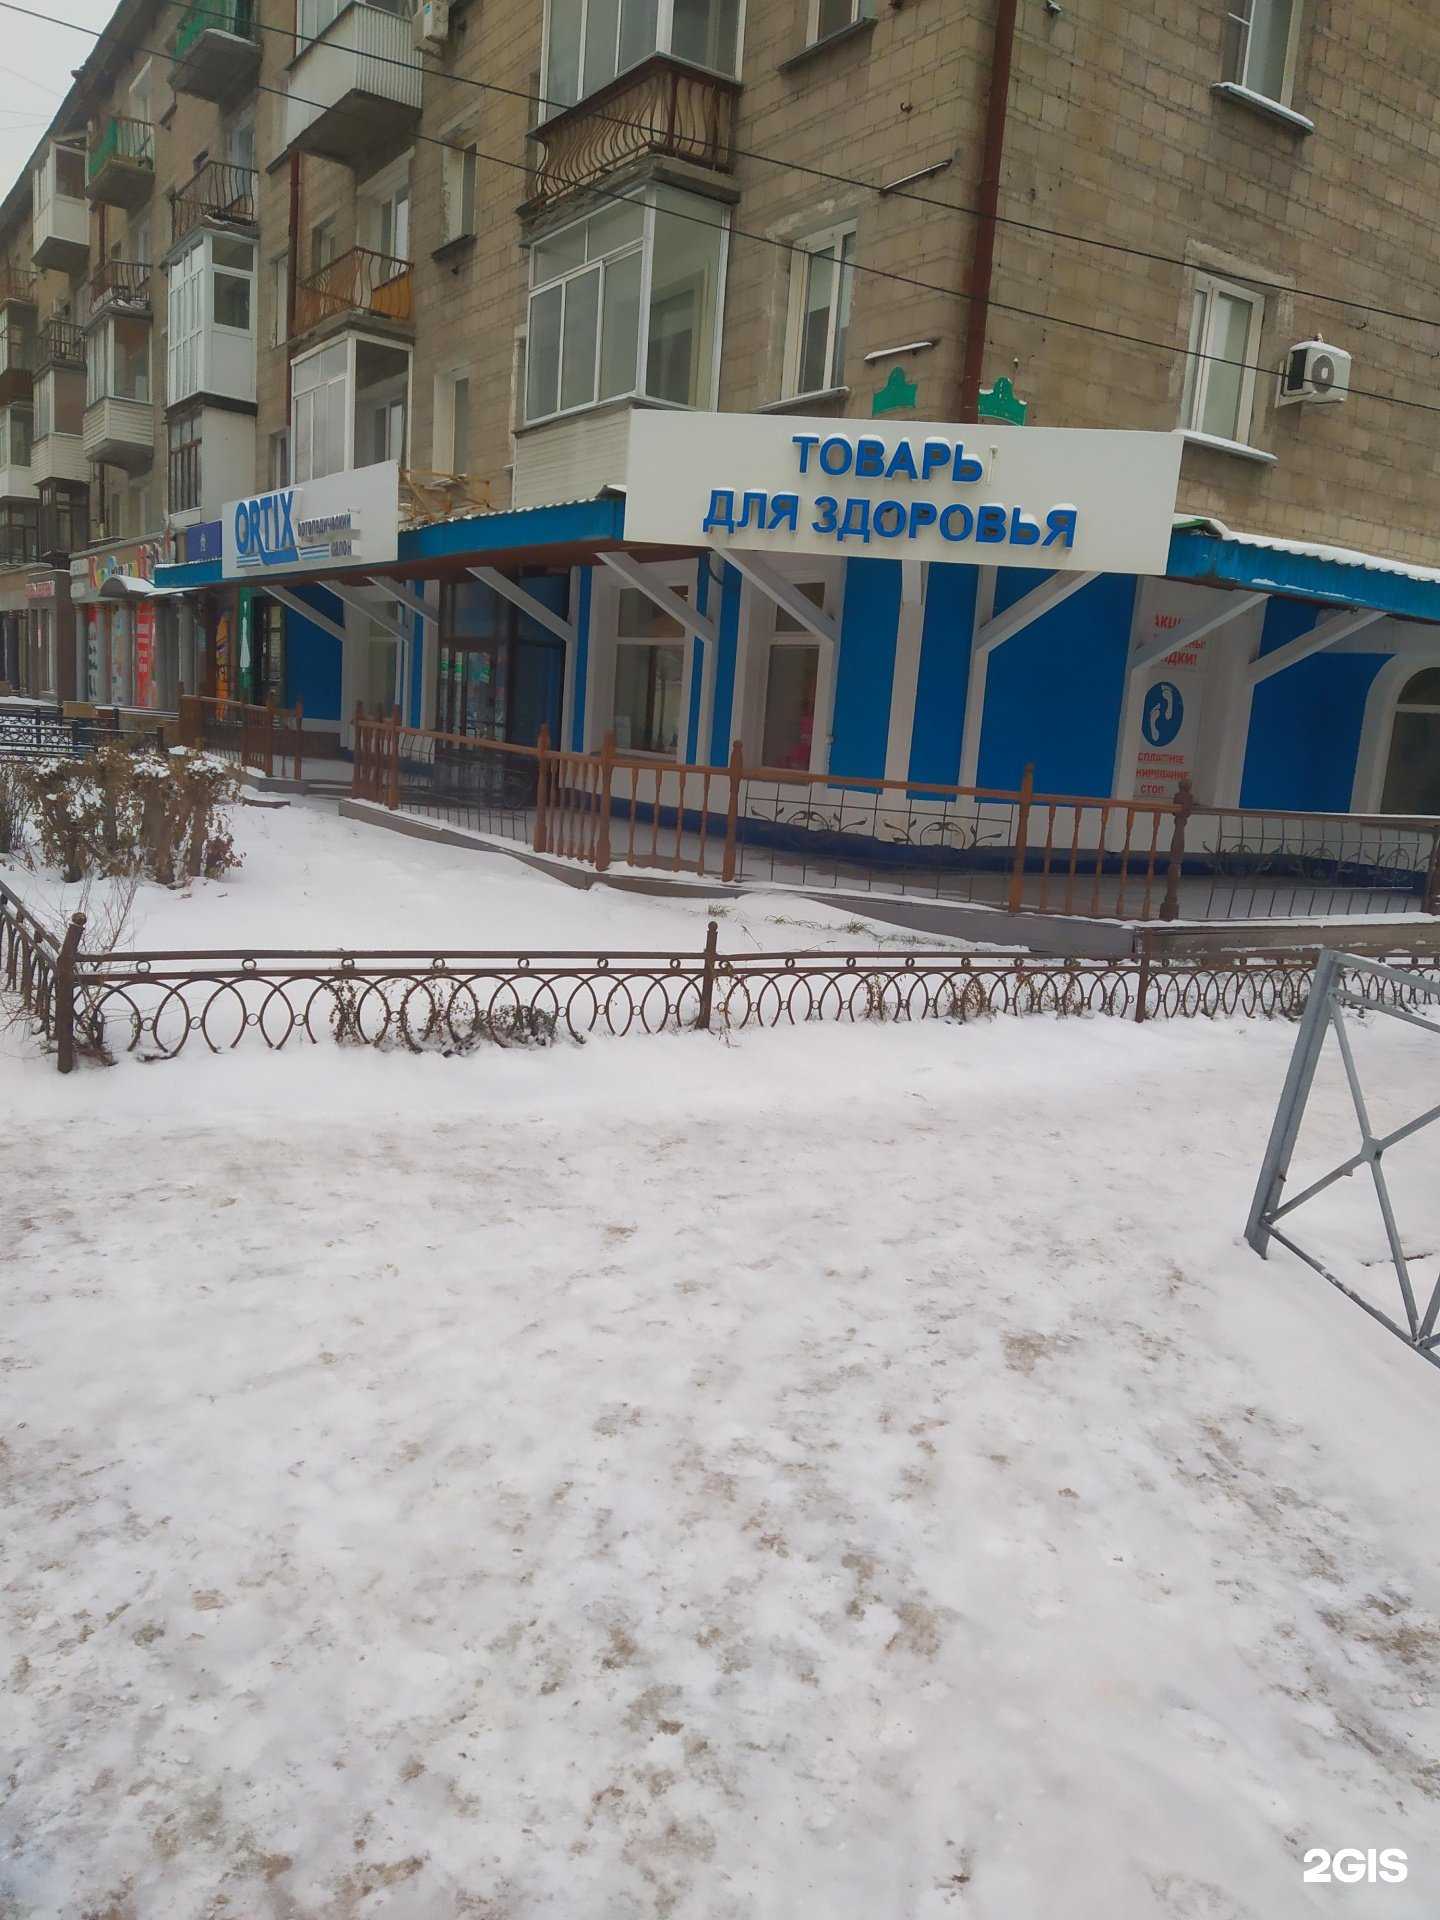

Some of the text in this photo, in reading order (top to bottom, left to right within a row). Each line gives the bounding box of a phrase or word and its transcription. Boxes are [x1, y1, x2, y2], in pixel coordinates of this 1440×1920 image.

[235, 490, 299, 565] ORTIX
[702, 488, 1079, 548] ДЛЯ ЗДОРОВЬЯ
